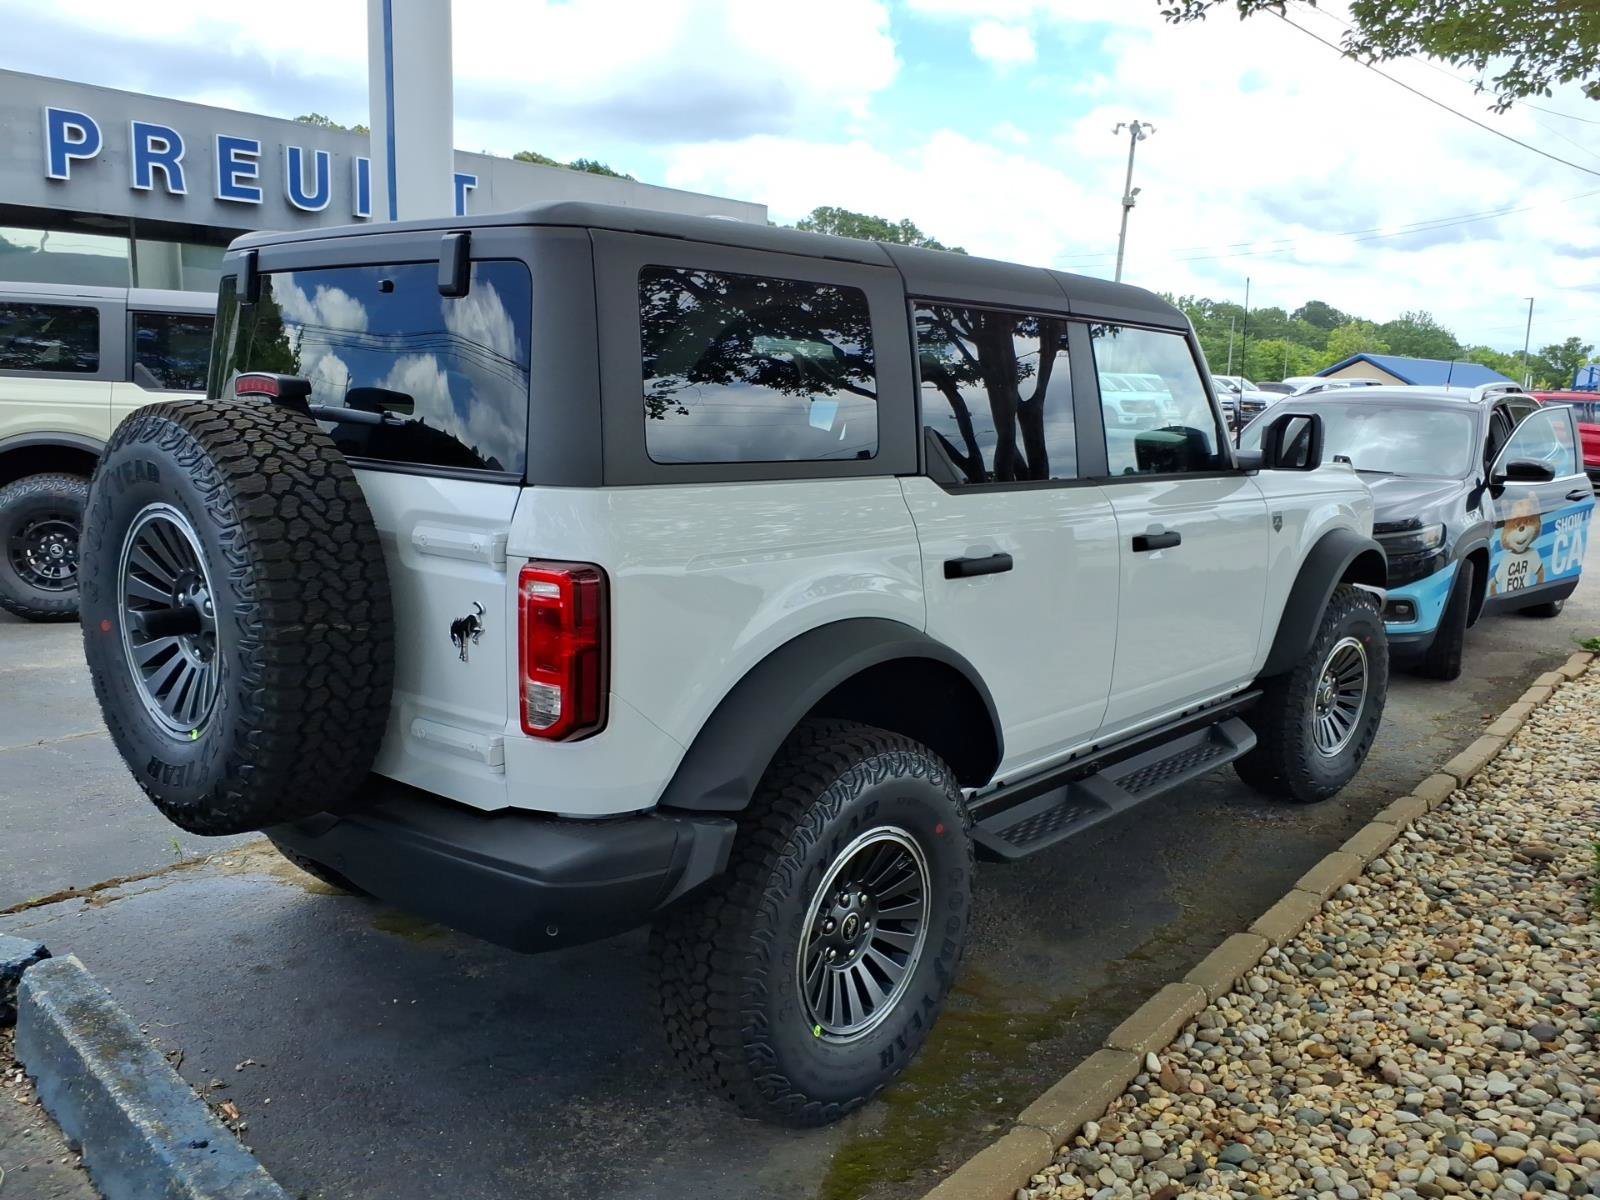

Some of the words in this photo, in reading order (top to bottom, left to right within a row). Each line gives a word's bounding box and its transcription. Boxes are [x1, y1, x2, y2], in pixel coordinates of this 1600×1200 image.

[44, 105, 477, 217] PREUIT
[1555, 511, 1583, 535] SHOW
[1508, 560, 1528, 576] CAR
[1507, 575, 1525, 592] FOX
